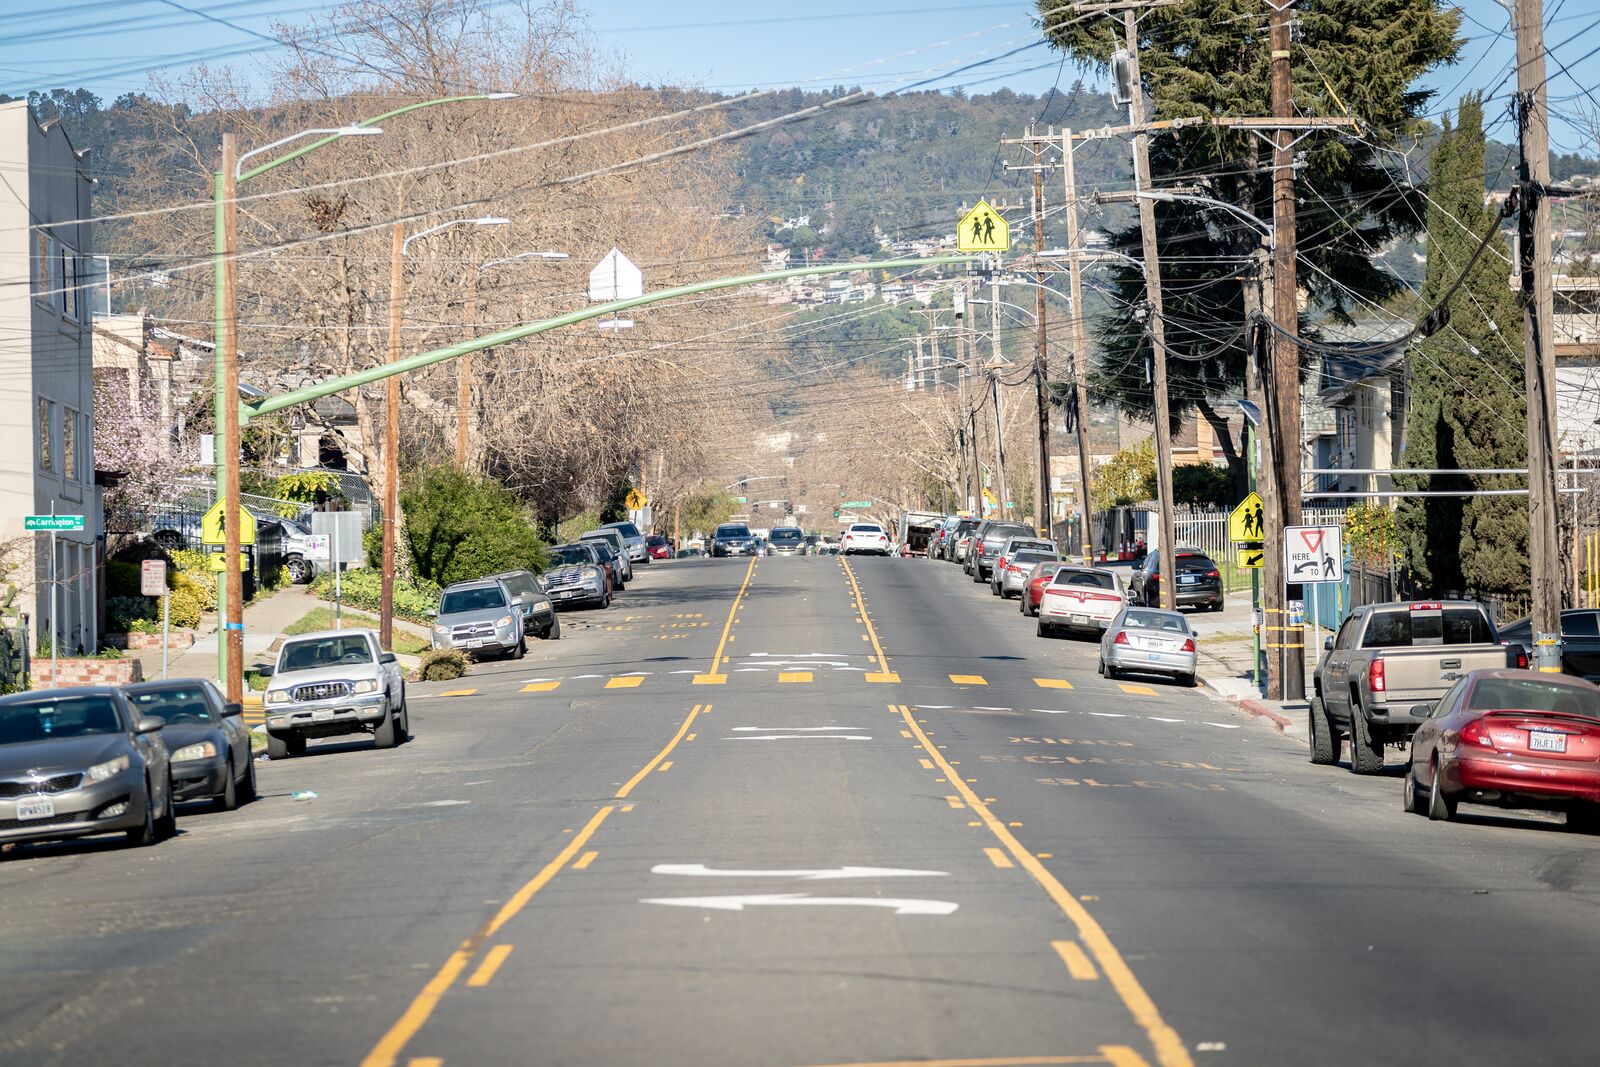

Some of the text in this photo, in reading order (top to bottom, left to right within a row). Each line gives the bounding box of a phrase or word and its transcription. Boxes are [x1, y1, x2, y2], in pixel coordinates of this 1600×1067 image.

[35, 518, 74, 527] Carrington
[1292, 553, 1311, 561] HERE
[1310, 568, 1319, 576] TO
[1533, 737, 1563, 748] 7HJE178
